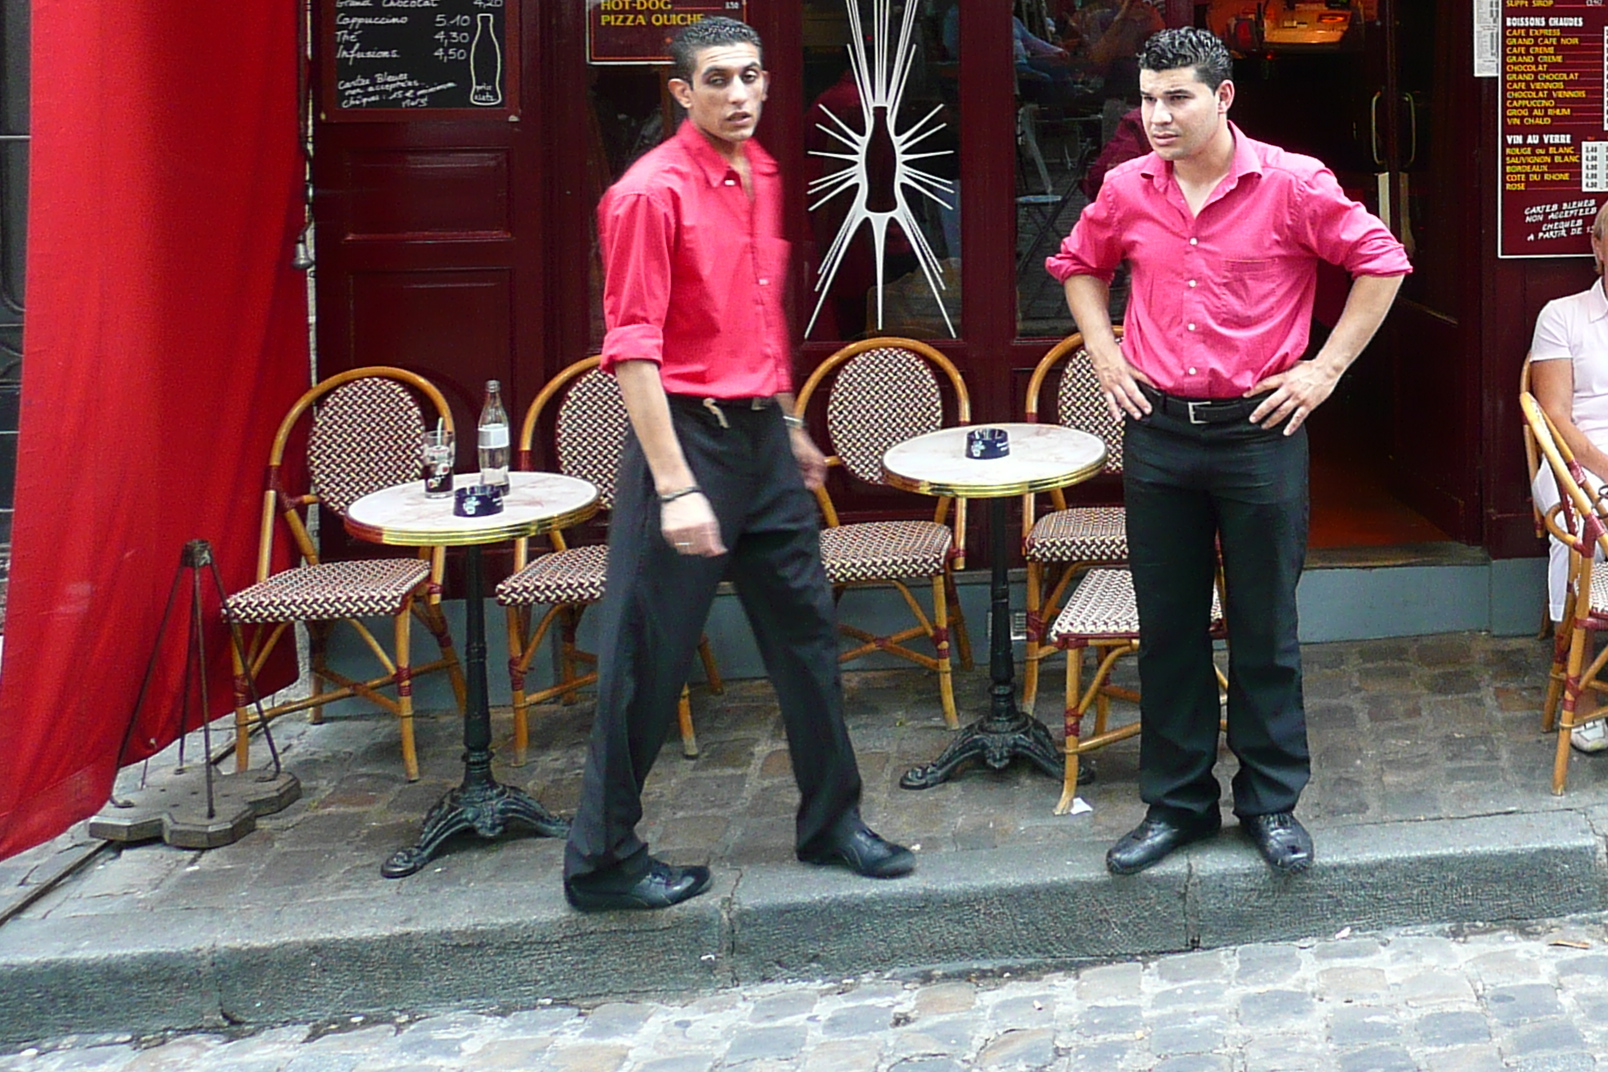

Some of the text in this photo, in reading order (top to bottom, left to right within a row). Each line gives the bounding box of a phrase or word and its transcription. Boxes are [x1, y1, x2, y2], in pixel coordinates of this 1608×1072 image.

[600, 0, 671, 10] HOT-DOG
[336, 13, 408, 28] Cappuccino
[600, 14, 646, 26] PIZZA
[1506, 17, 1583, 26] BOISSONS CHAUDES
[336, 30, 470, 46] Thé 4,30
[336, 43, 466, 66] Infusions 4,50
[338, 75, 370, 90] Cartes
[1506, 134, 1571, 144] VIN AU VERRE
[1506, 147, 1531, 155] ROUGE
[1524, 204, 1558, 215] CARTES
[1525, 207, 1597, 223] NON ACCEPTEES
[1542, 219, 1583, 231] CHEQUES
[1538, 229, 1567, 240] PARTIR
[1570, 227, 1582, 235] DE
